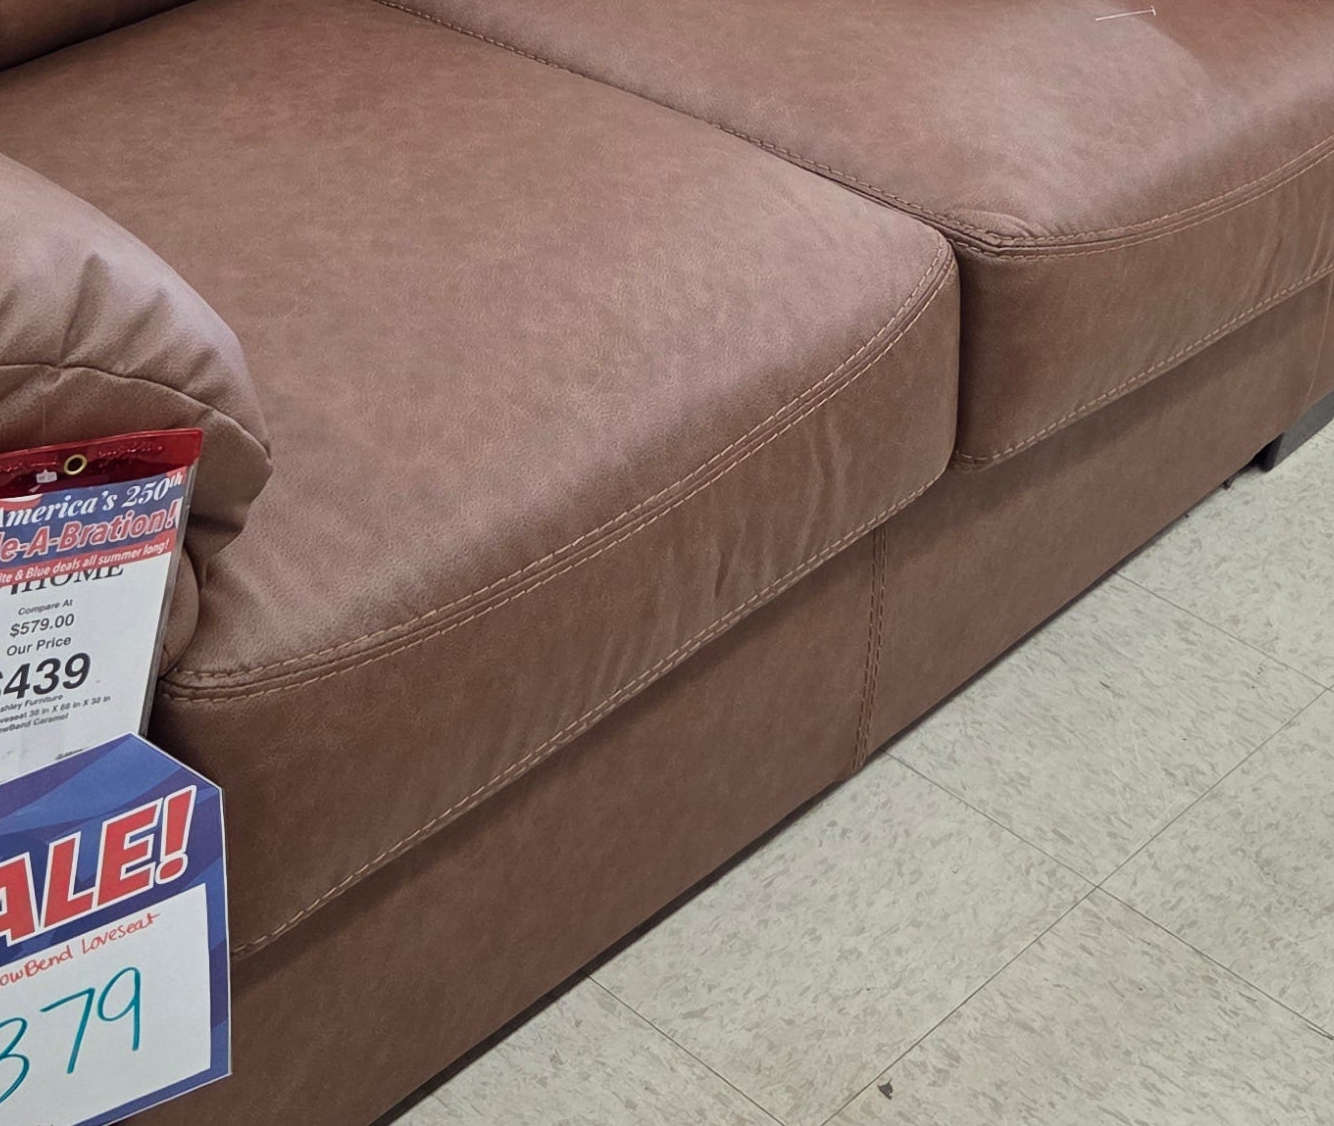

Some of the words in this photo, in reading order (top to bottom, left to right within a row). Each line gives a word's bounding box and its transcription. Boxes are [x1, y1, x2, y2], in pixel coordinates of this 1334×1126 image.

[122, 473, 184, 508] 250th
[15, 569, 23, 580] &
[26, 564, 50, 579] Blue
[53, 558, 80, 573] deals
[82, 554, 96, 568] all
[98, 547, 141, 566] summer
[142, 538, 170, 557] long!
[18, 600, 60, 616] Compare
[62, 598, 74, 608] At
[9, 613, 74, 638] $579.00
[6, 642, 33, 657] Our
[36, 635, 72, 652] Price
[81, 911, 161, 955] Loveseat
